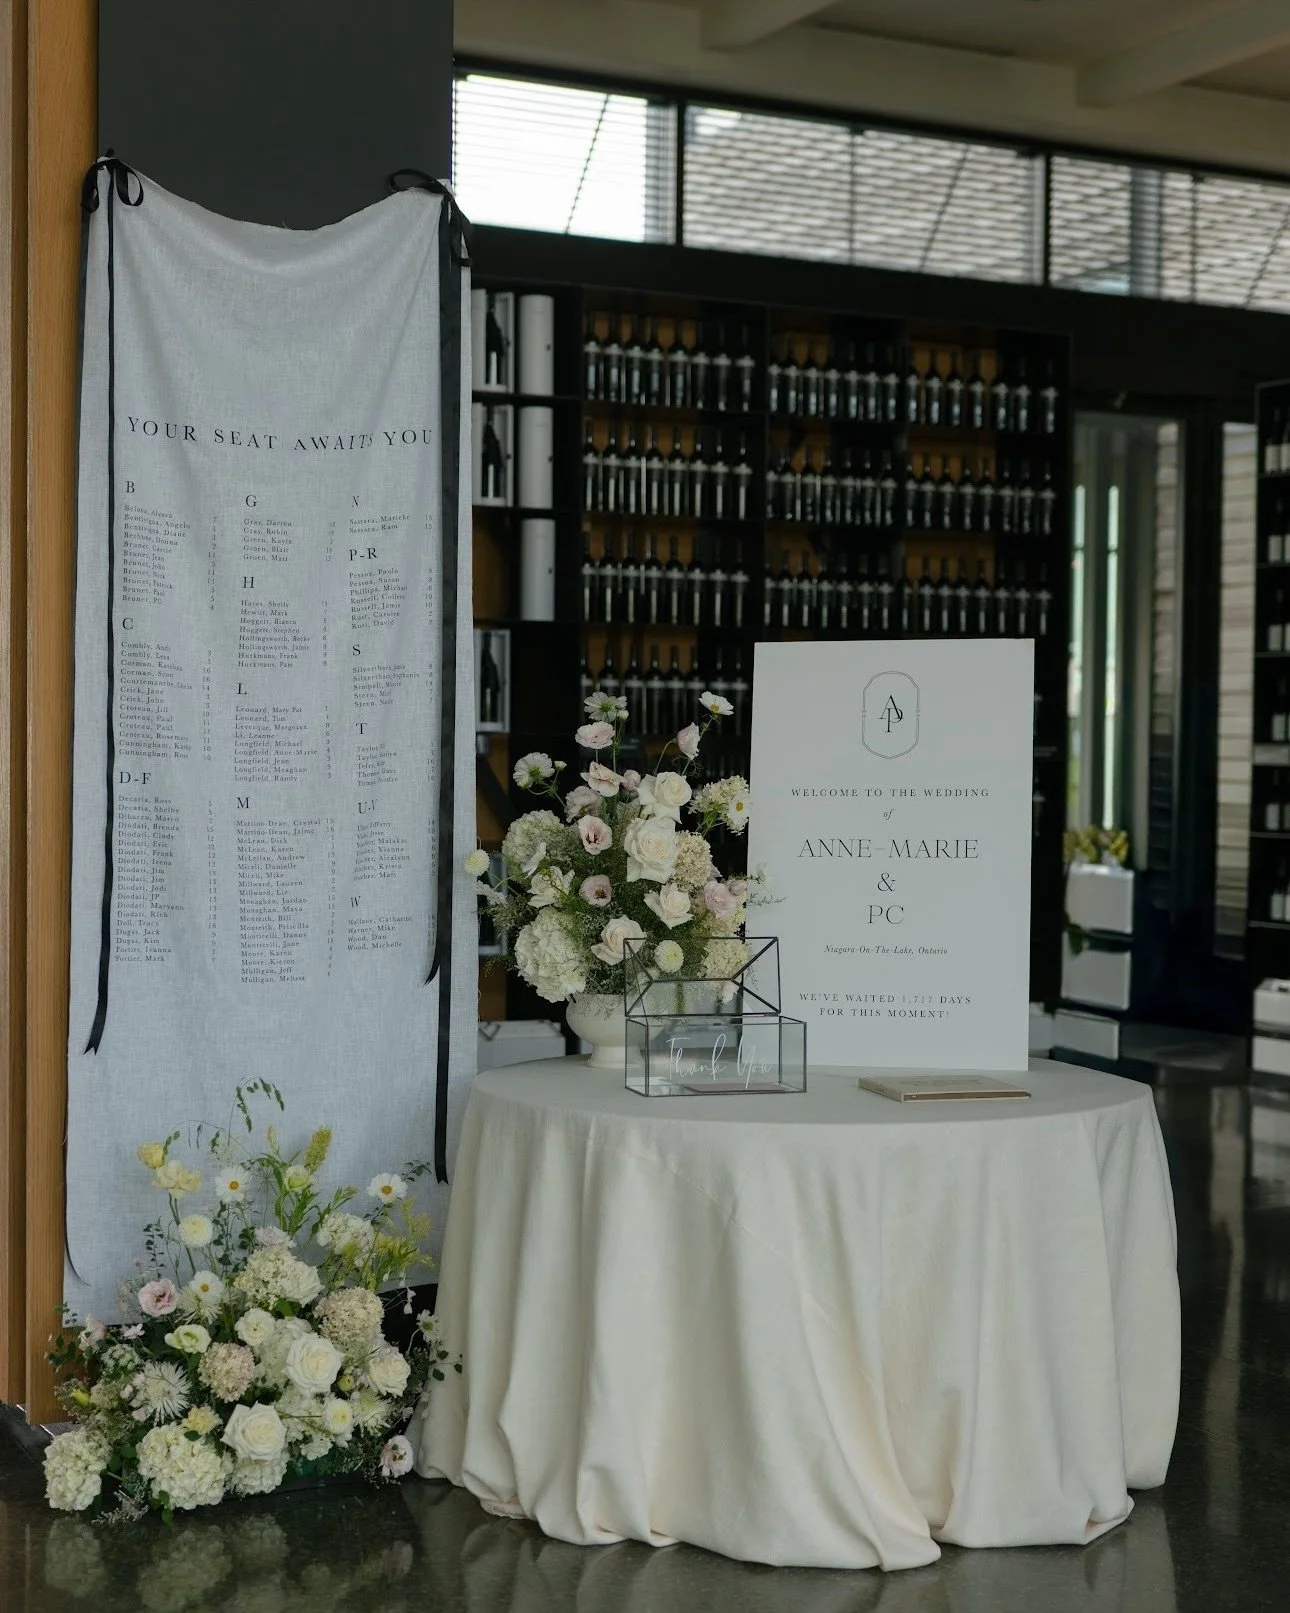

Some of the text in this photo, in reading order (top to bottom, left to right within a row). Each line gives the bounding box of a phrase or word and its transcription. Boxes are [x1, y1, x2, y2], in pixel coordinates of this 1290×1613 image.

[128, 416, 431, 450] YOUR SEAT AWAITS YOU
[125, 481, 135, 493] B
[245, 495, 256, 507] G
[352, 496, 359, 508] N
[349, 548, 378, 561] P-R
[243, 576, 255, 589] H
[123, 618, 134, 630] C
[352, 645, 361, 656] S
[237, 683, 247, 695] L
[356, 723, 367, 734] T
[119, 771, 152, 784] D-F
[791, 789, 989, 797] WELCOME TO THE WEDDING
[236, 797, 250, 809] M
[883, 809, 894, 820] of
[798, 838, 979, 859] ANNE-MARIE
[877, 872, 896, 892] &
[350, 896, 361, 908] W
[867, 905, 904, 924] PC
[824, 945, 948, 955] Niagara-On-The-Lake, Ontario
[800, 994, 971, 1004] WE'VE WAITED 1,717 DAYS
[820, 1008, 845, 1016] FOR
[888, 1009, 950, 1018] MOMENT!
[666, 1034, 772, 1089] Thank You
